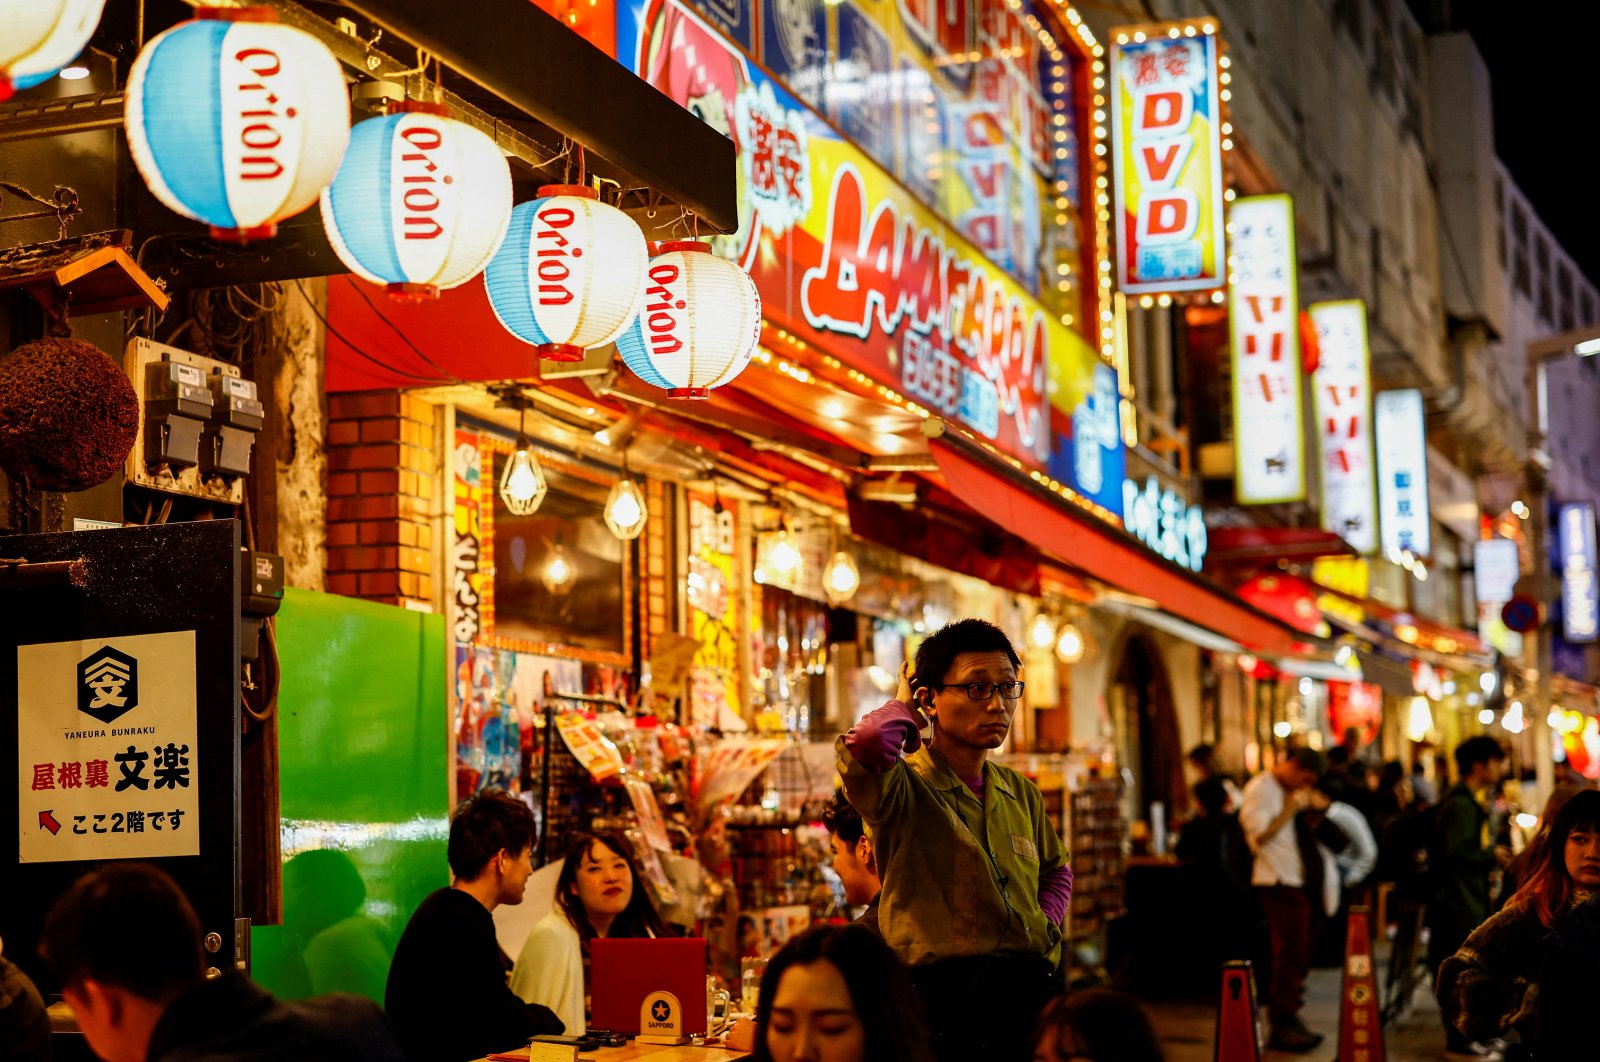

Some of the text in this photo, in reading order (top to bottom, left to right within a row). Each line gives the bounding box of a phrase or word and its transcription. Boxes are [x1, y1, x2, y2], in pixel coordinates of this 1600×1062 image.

[235, 48, 297, 181] Orion
[401, 126, 453, 240] Orion
[1141, 91, 1188, 236] DVD
[537, 207, 583, 306] Orion
[646, 264, 687, 355] Orion
[64, 726, 155, 740] YANEURA BUNRAKU
[89, 673, 128, 708] 文
[72, 808, 185, 835] ここ2階です
